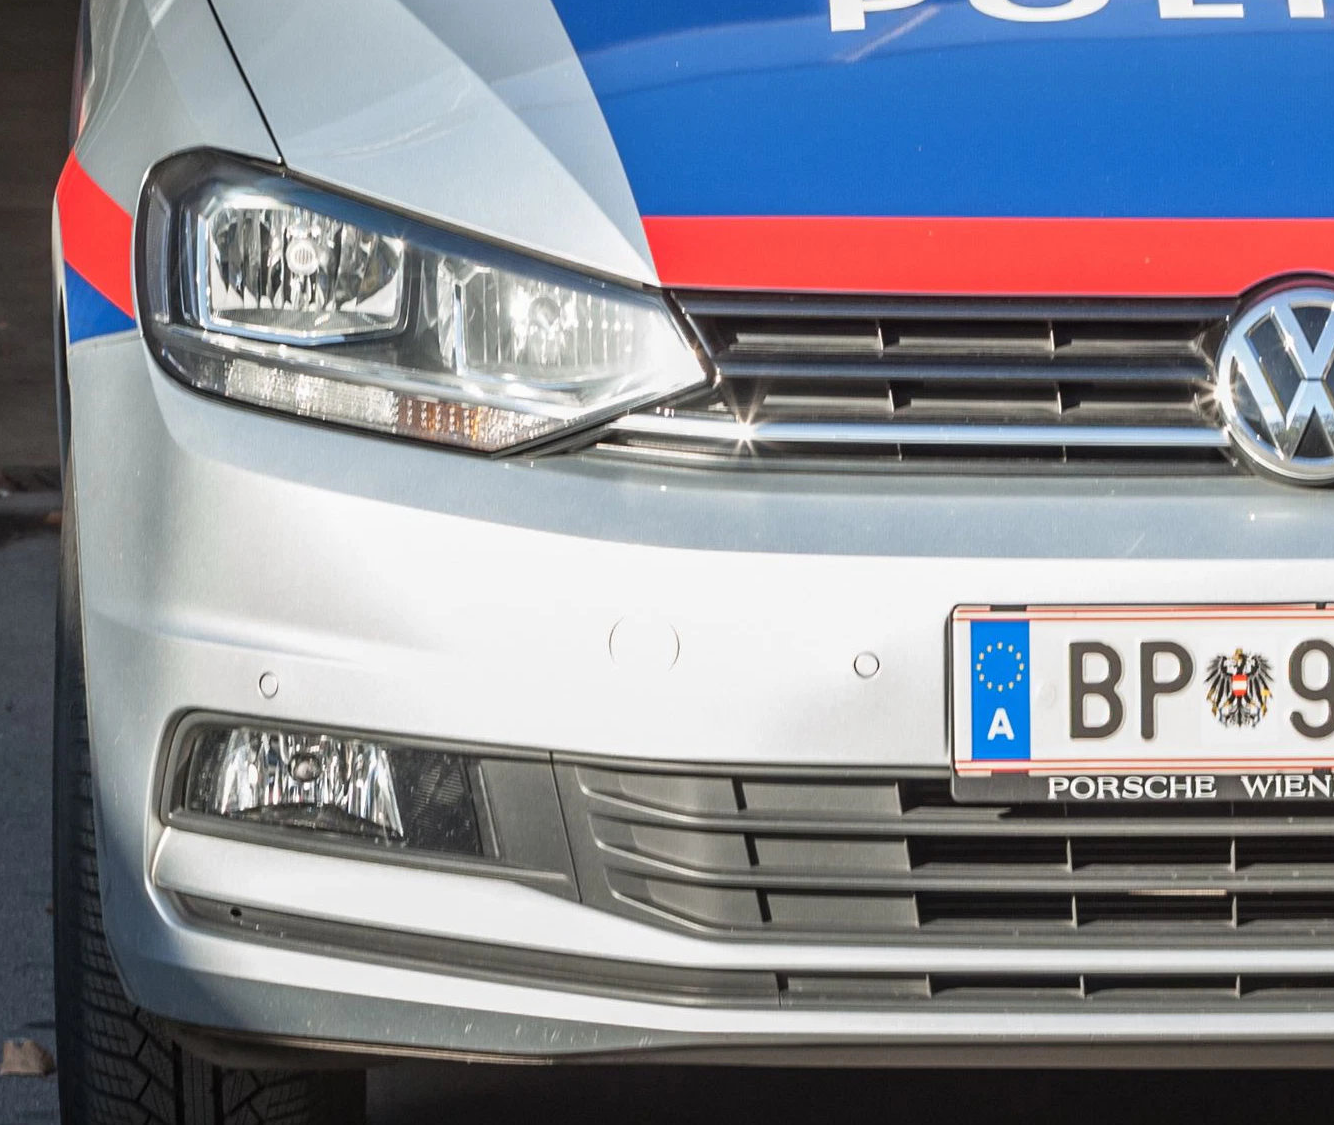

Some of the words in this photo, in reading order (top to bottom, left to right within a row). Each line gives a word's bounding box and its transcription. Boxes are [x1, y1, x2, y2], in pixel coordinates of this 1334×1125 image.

[1068, 640, 1195, 742] BP
[987, 707, 1015, 741] A
[1047, 775, 1218, 800] PORSCHE
